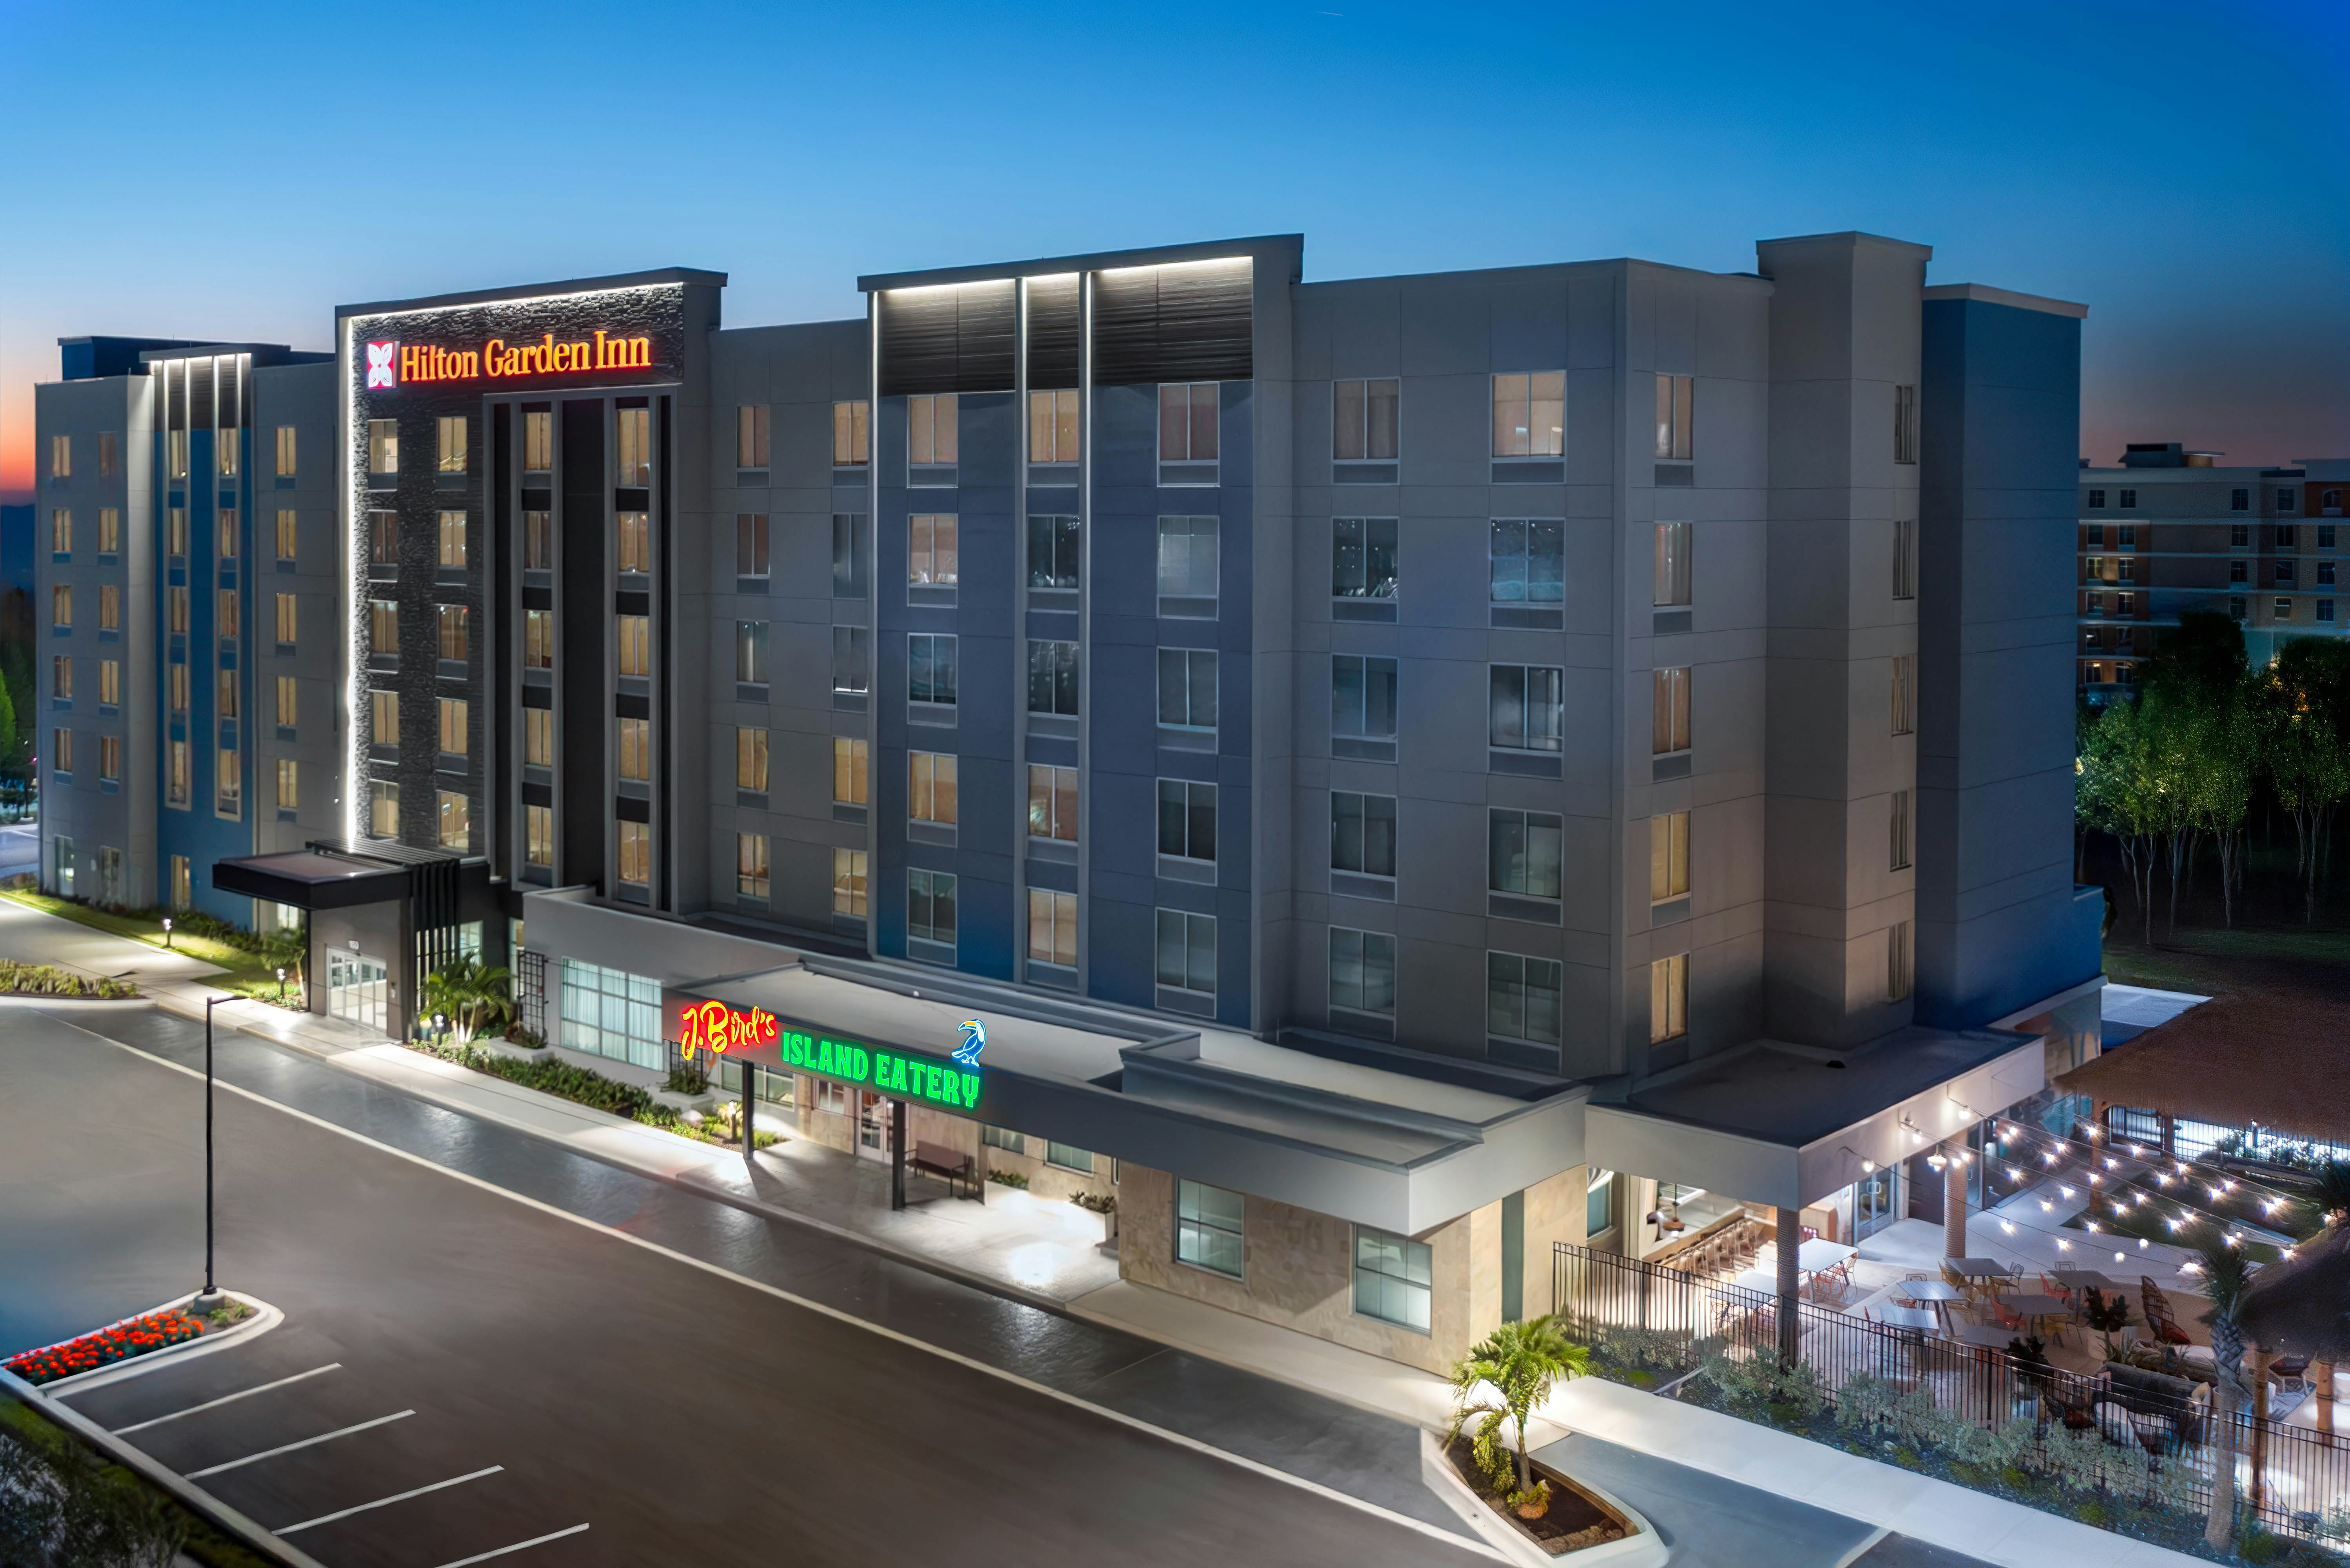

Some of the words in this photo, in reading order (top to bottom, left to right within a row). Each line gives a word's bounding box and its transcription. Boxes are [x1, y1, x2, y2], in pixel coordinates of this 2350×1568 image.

[401, 345, 478, 381] Hilton
[485, 334, 591, 376] Garden
[594, 330, 651, 369] Inn
[782, 1032, 869, 1080] ISLAND
[875, 1053, 980, 1108] EATERY
